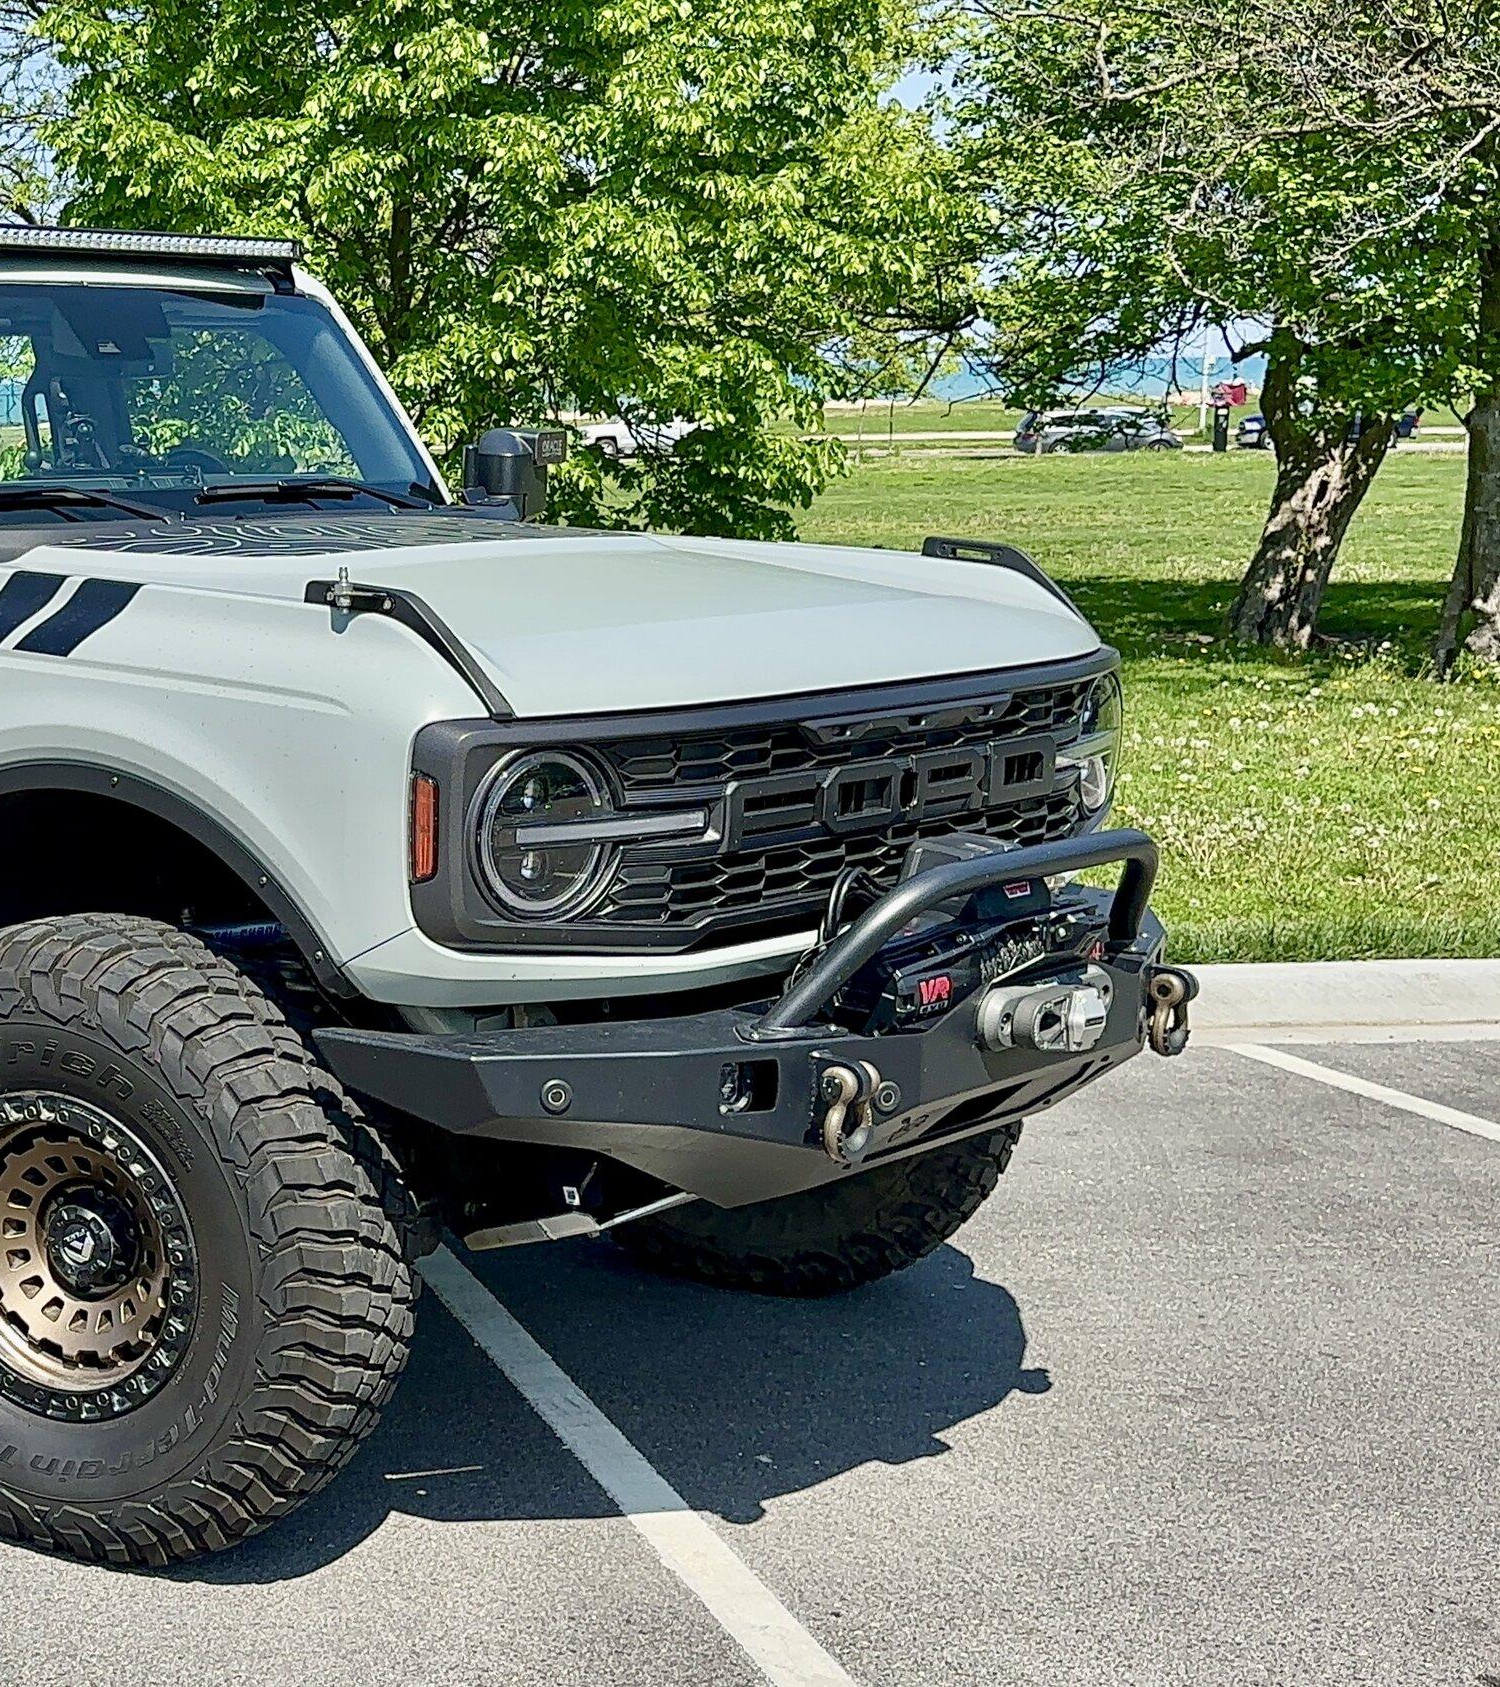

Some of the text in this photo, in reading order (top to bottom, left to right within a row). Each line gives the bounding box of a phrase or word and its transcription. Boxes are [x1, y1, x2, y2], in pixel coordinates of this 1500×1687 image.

[718, 735, 1056, 853] FORD
[920, 976, 950, 1005] VR
[28, 1281, 240, 1483] Mud-Terrain
